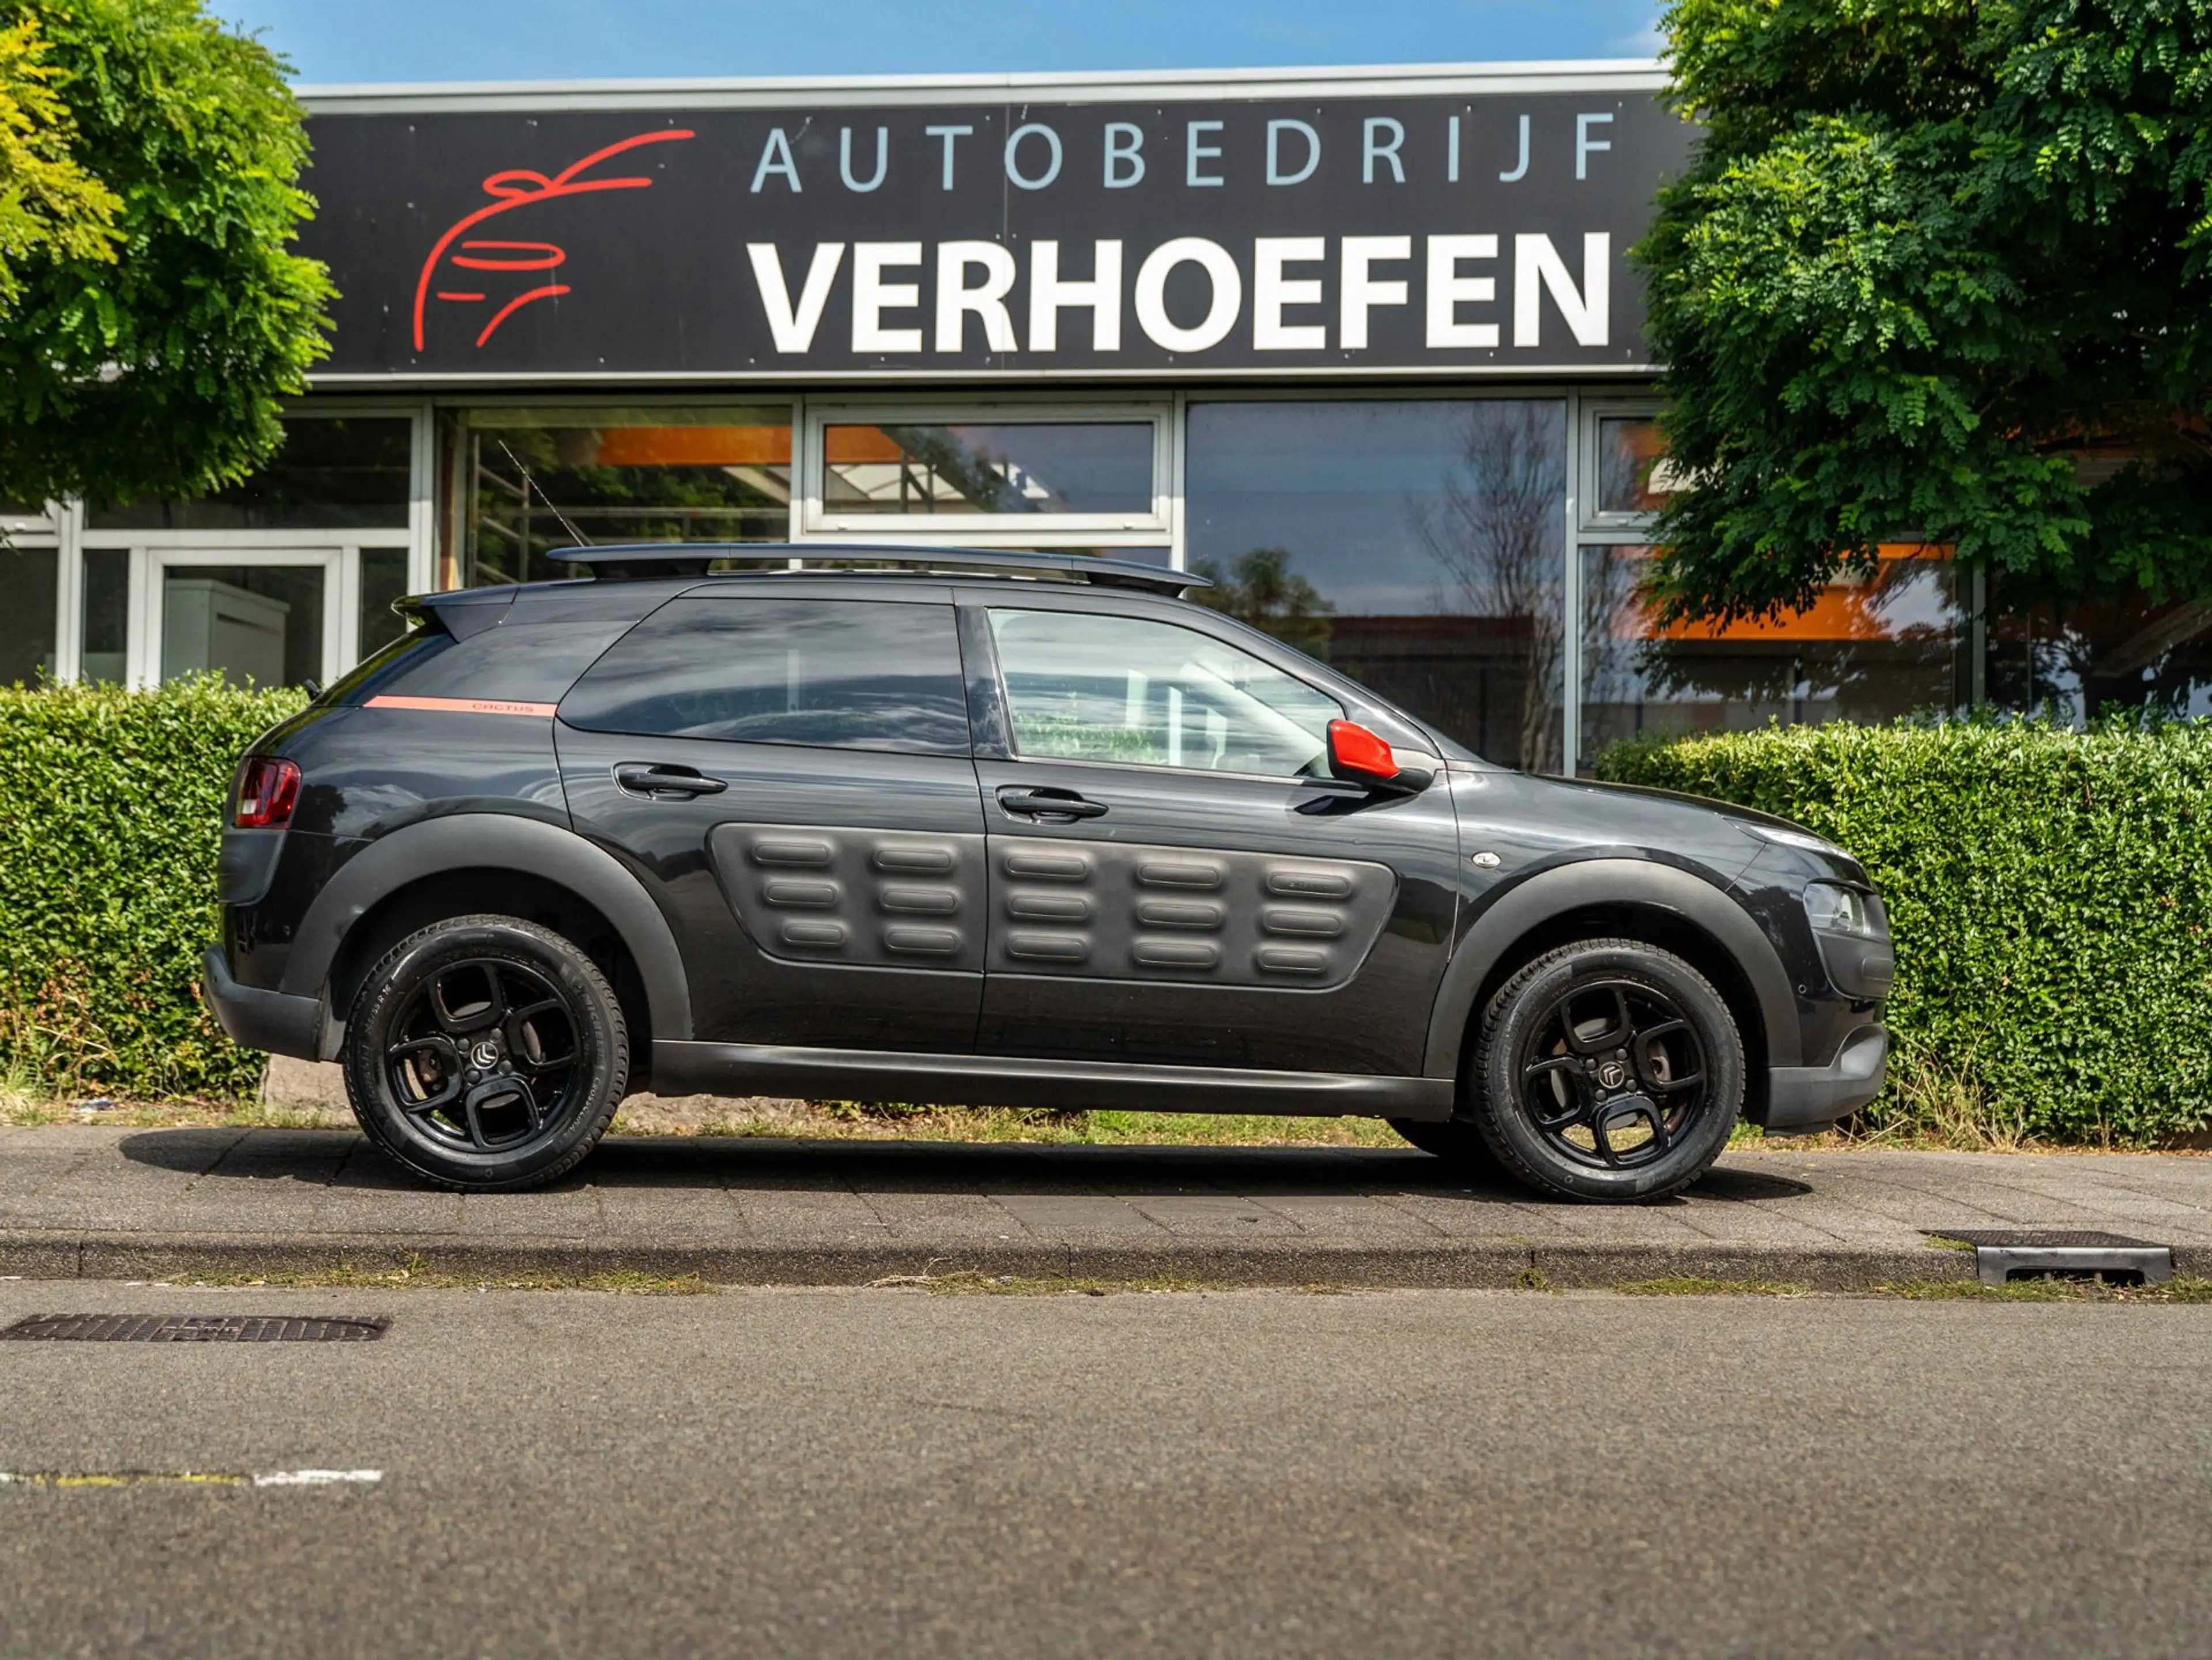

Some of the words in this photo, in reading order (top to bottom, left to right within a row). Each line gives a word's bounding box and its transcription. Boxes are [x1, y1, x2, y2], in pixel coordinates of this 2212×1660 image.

[750, 112, 1614, 193] AUTOBEDRIJF
[746, 232, 1610, 353] VERHOEFEN
[472, 703, 534, 712] CACTUS
